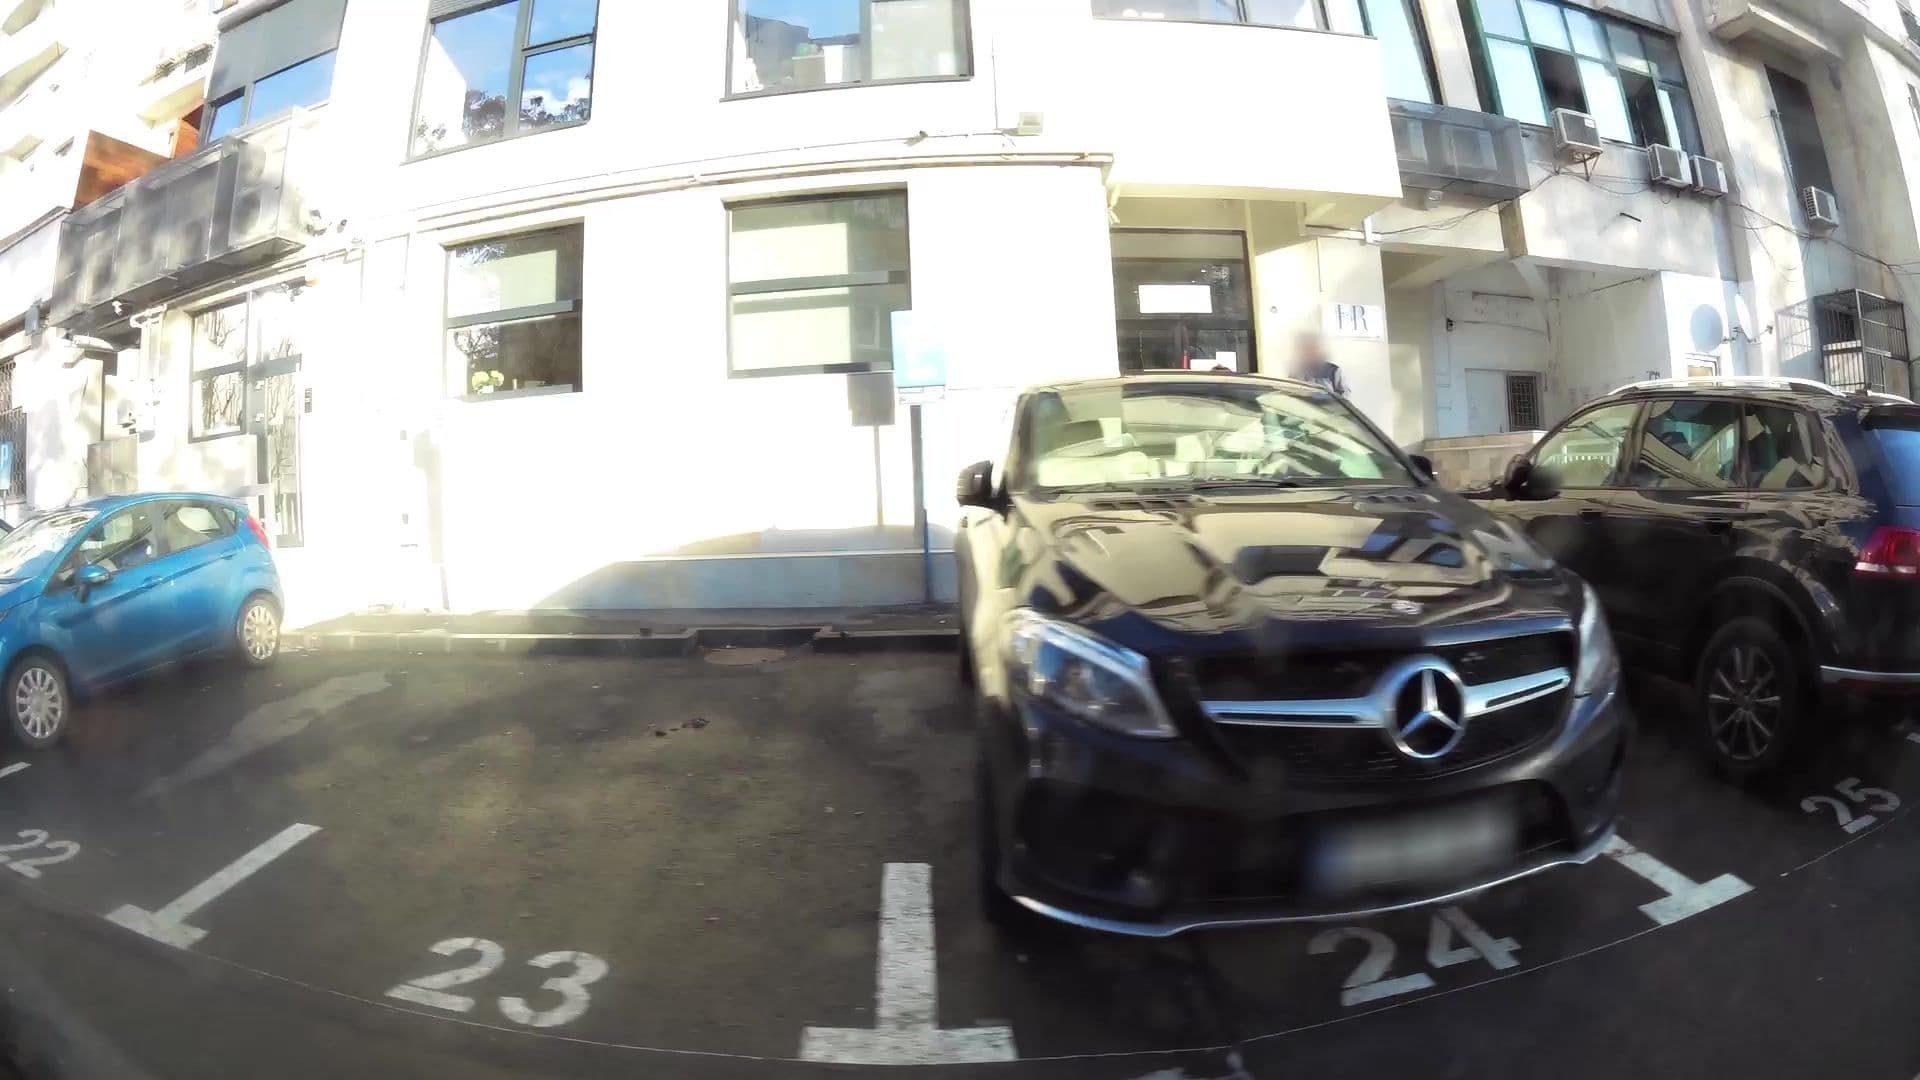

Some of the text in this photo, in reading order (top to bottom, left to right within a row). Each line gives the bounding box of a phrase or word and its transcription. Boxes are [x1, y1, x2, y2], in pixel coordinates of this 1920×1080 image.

[1800, 777, 1900, 834] 25
[0, 828, 81, 879] 22
[384, 937, 609, 1027] 23
[1307, 906, 1521, 1007] 24
